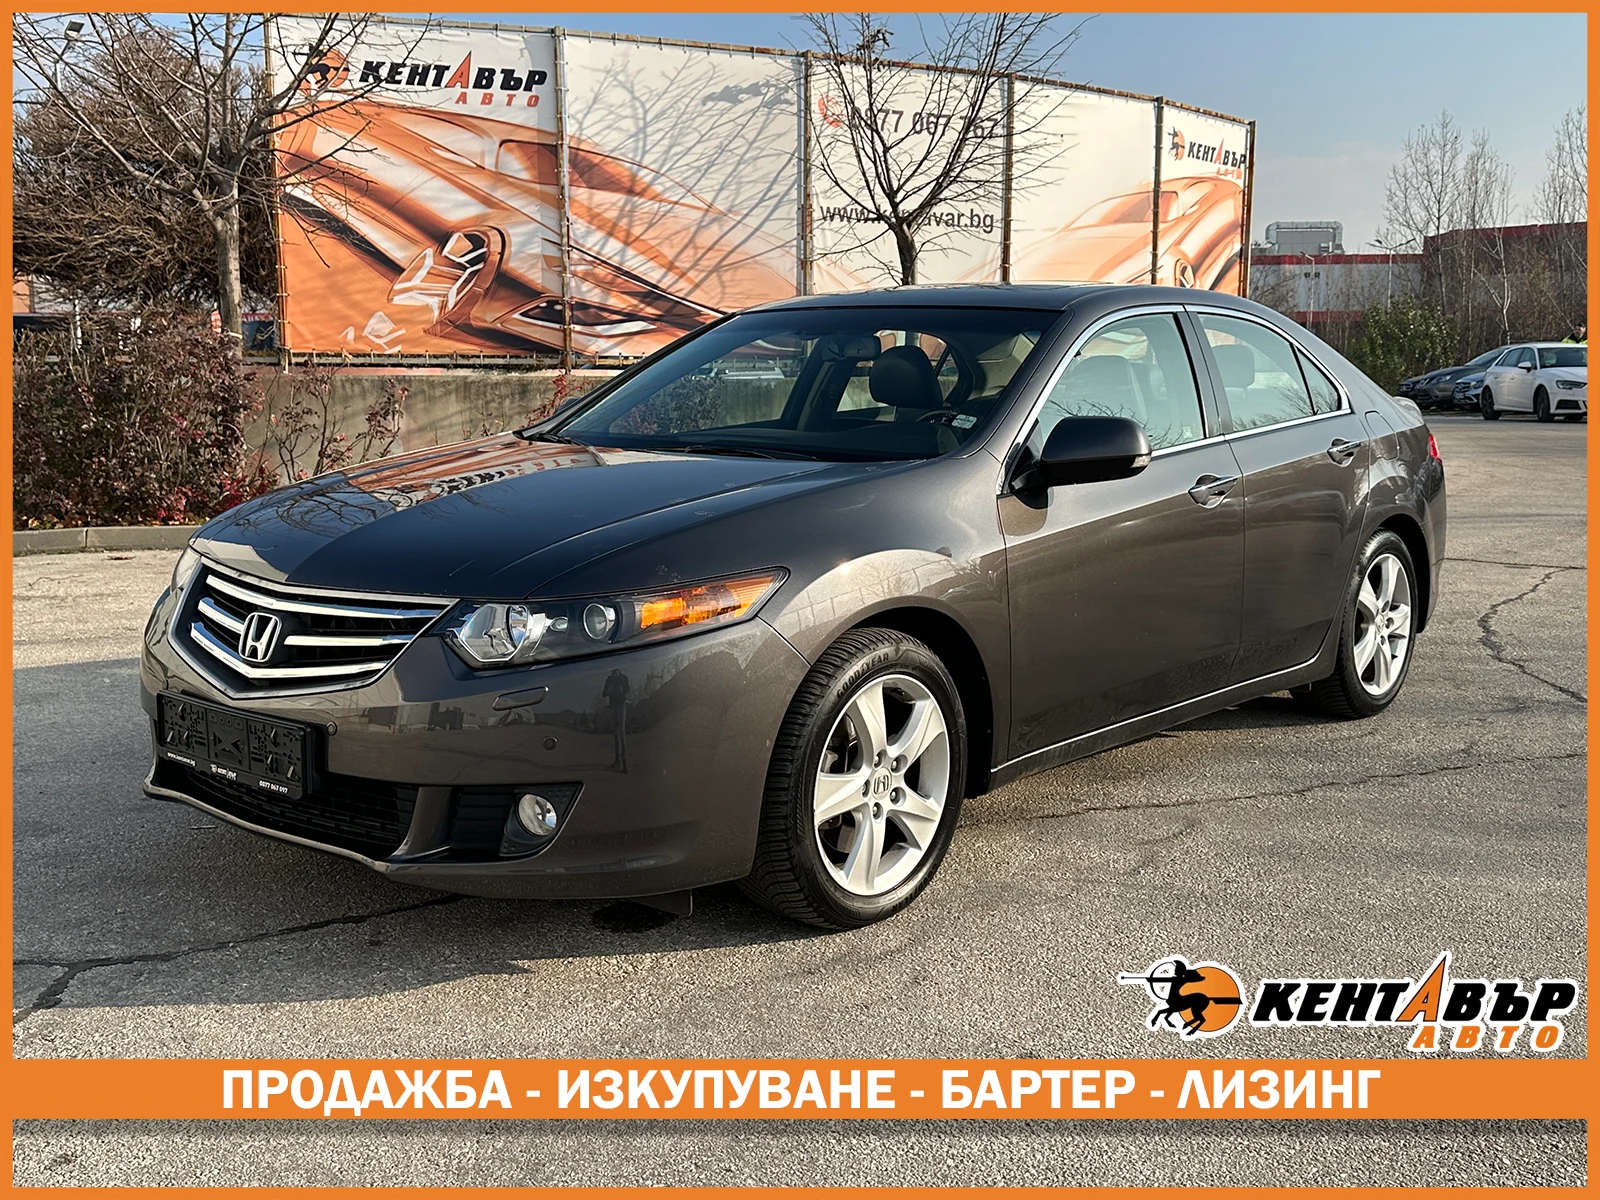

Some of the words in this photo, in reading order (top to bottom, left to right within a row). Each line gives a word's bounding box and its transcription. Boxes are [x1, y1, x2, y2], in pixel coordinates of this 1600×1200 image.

[359, 50, 547, 92] КЕНТАВЪР
[455, 91, 540, 107] АВТО
[912, 112, 951, 136] 067
[1187, 138, 1247, 168] КЕНТАВЪР
